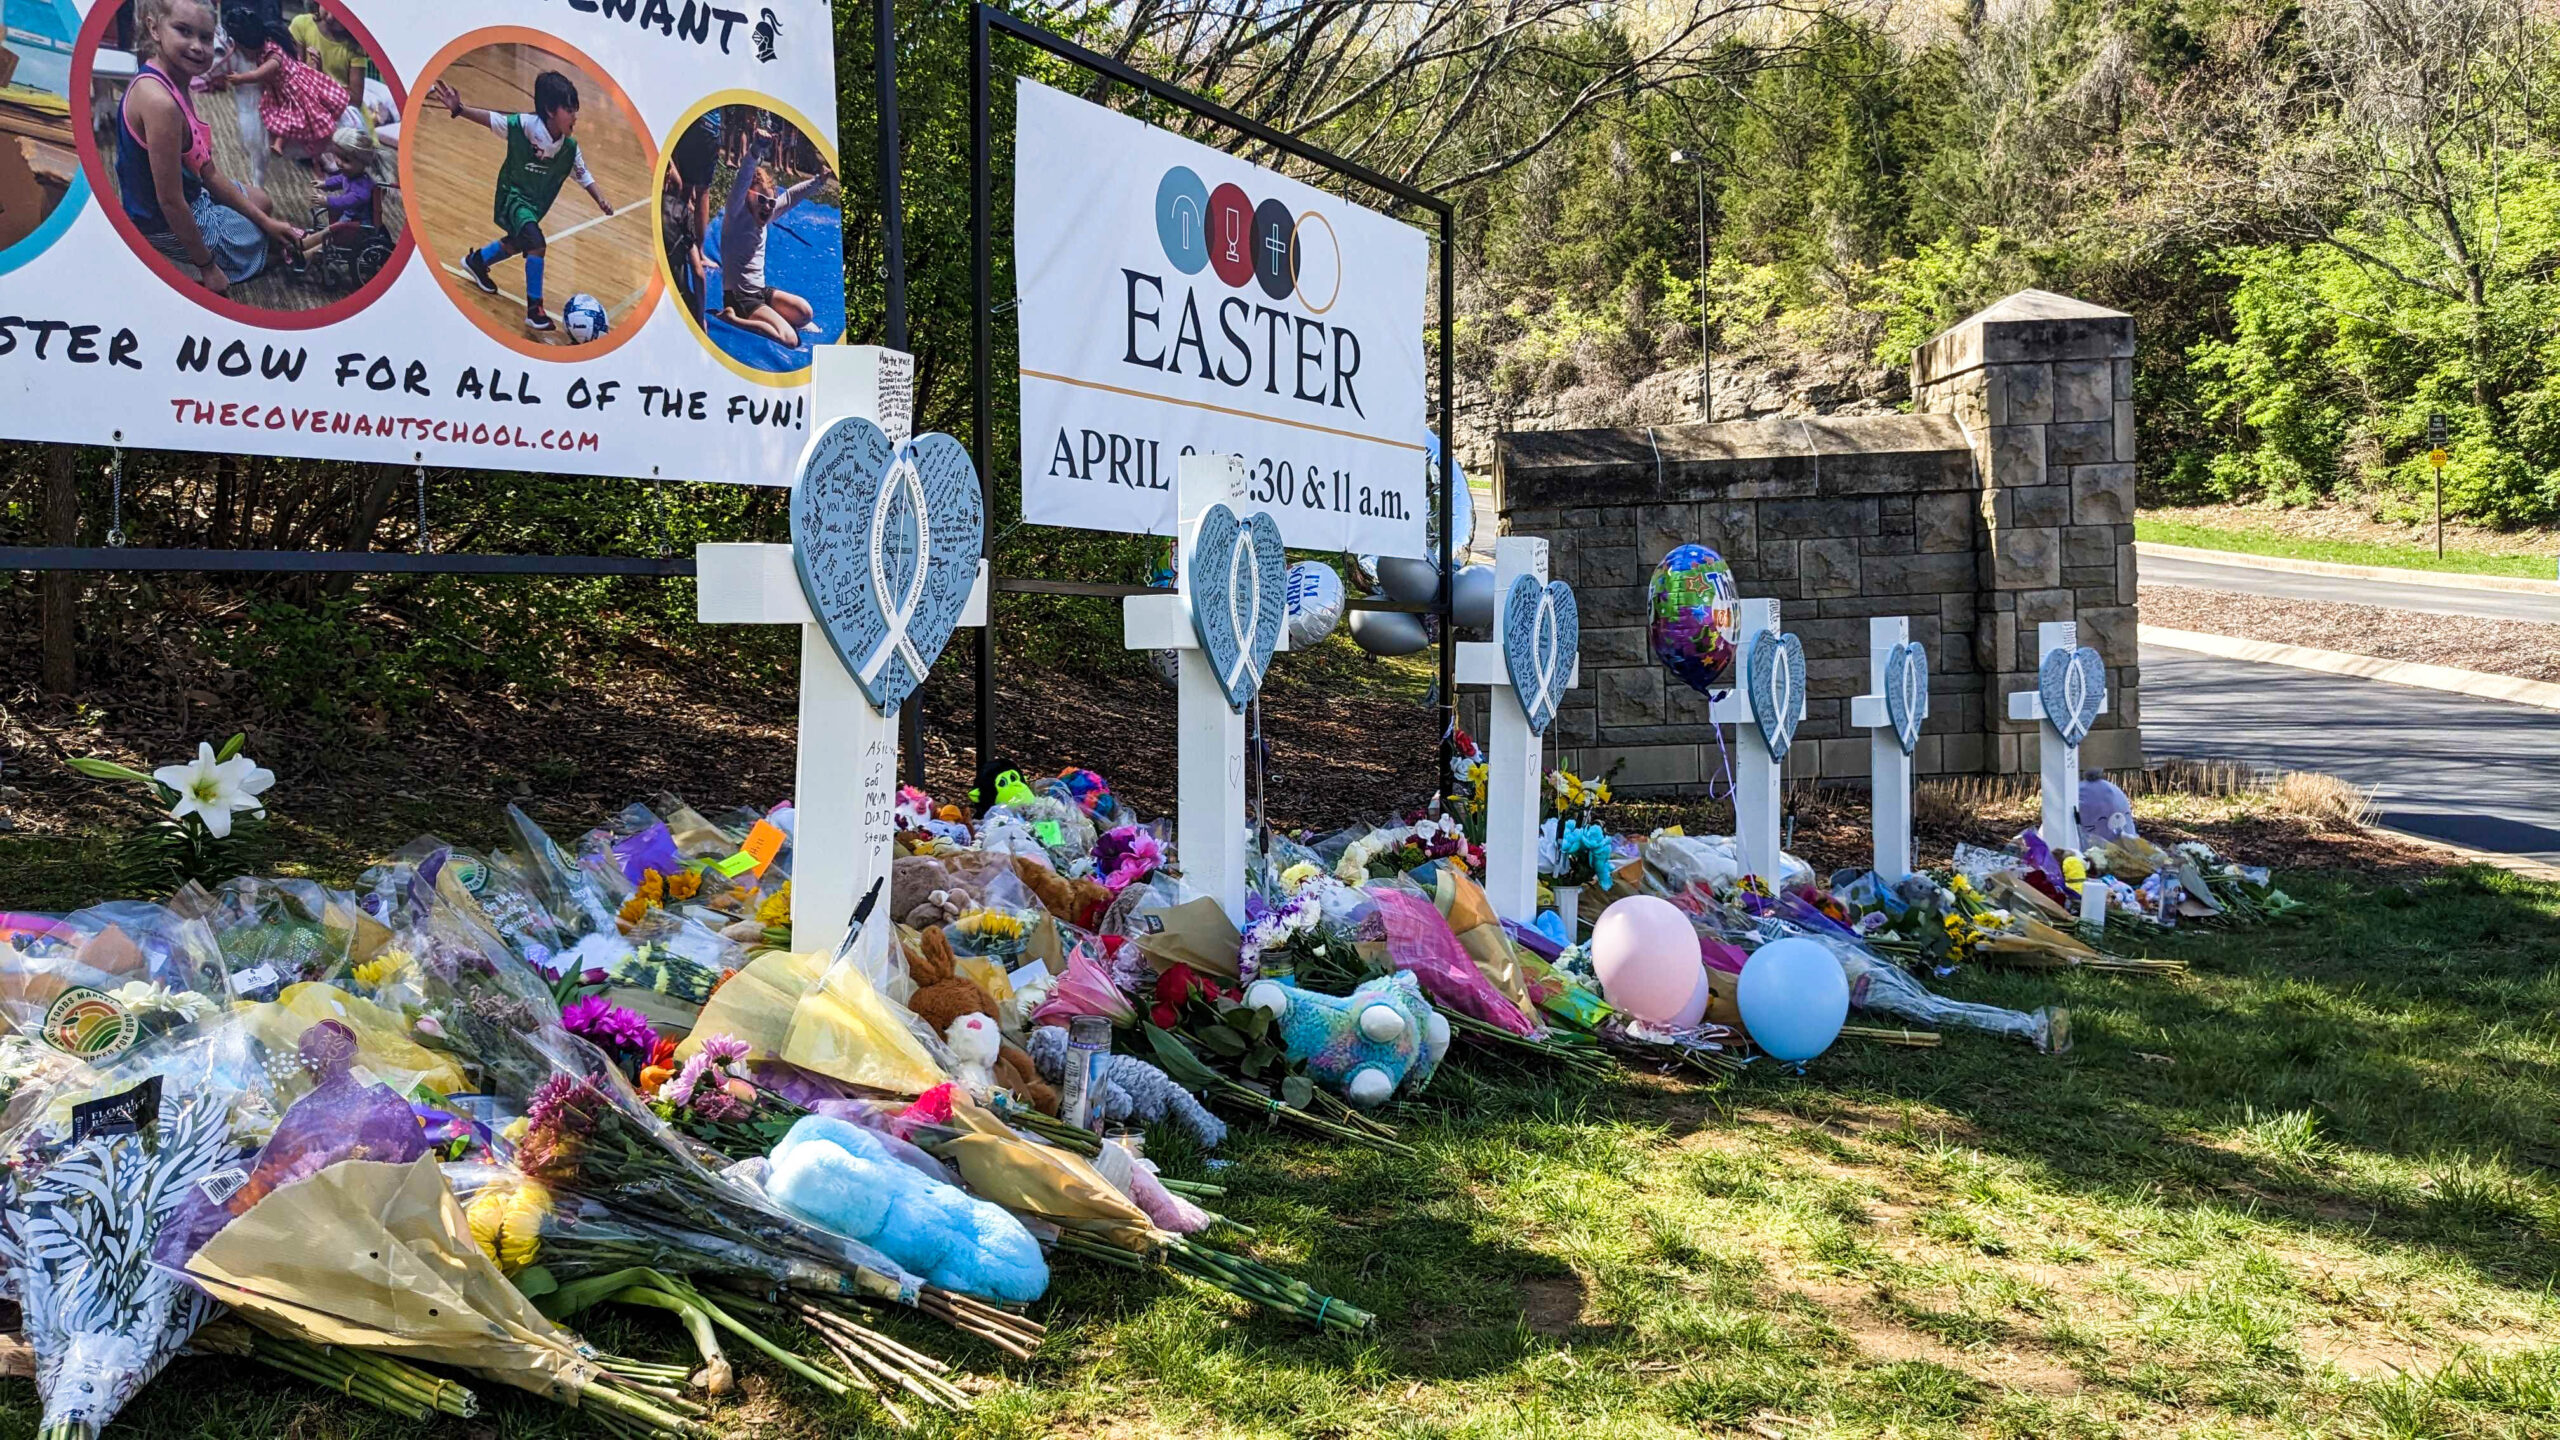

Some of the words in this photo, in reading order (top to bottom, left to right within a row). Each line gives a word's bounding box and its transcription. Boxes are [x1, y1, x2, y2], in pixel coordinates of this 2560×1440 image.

[1121, 268, 1366, 420] EASTER
[0, 316, 142, 370] STER
[176, 335, 308, 382] NOW
[335, 353, 431, 396] FOR
[457, 366, 541, 404] ALL
[567, 377, 621, 411] OF
[638, 385, 707, 421] THE
[728, 395, 803, 430] FUN!
[170, 399, 599, 452] THECOVENANTSCHOOL.COM
[1048, 426, 1169, 491] APRIL
[1233, 453, 1294, 505] :30
[1302, 465, 1326, 509] &
[1360, 486, 1410, 520] a.m.
[878, 500, 887, 520] who
[1287, 566, 1305, 616] SORRY
[1303, 575, 1320, 597] I'M
[51, 997, 75, 1022] FOODS
[115, 1036, 130, 1051] FOR
